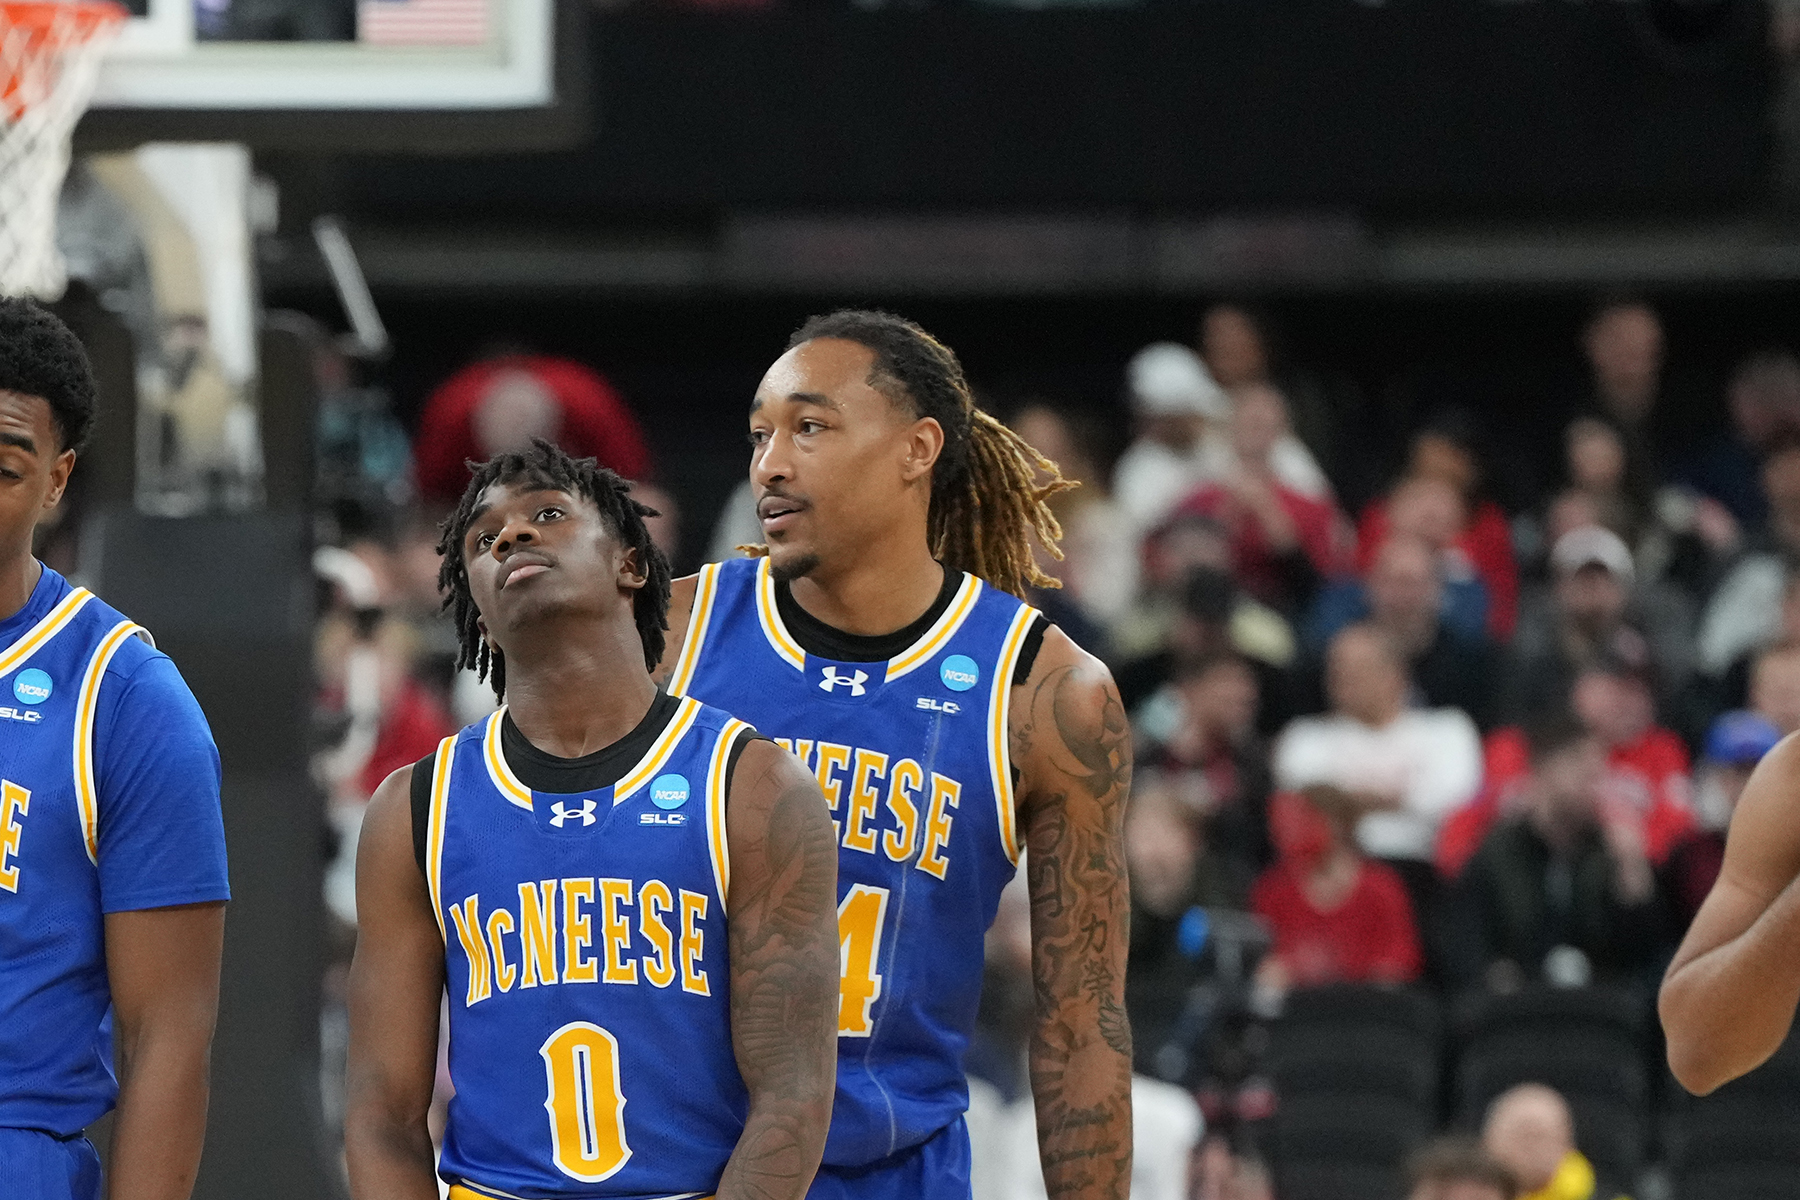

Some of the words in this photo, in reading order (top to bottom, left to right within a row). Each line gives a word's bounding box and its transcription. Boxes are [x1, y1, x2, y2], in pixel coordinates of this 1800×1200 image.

[944, 669, 976, 684] NCAA
[17, 683, 49, 698] NCAA
[915, 697, 961, 713] SLC
[654, 789, 687, 801] NCAA
[774, 738, 962, 882] EESE
[640, 813, 686, 824] SLC
[449, 877, 711, 1008] McNEESE
[837, 884, 890, 1038] 4
[538, 1021, 633, 1183] 0
